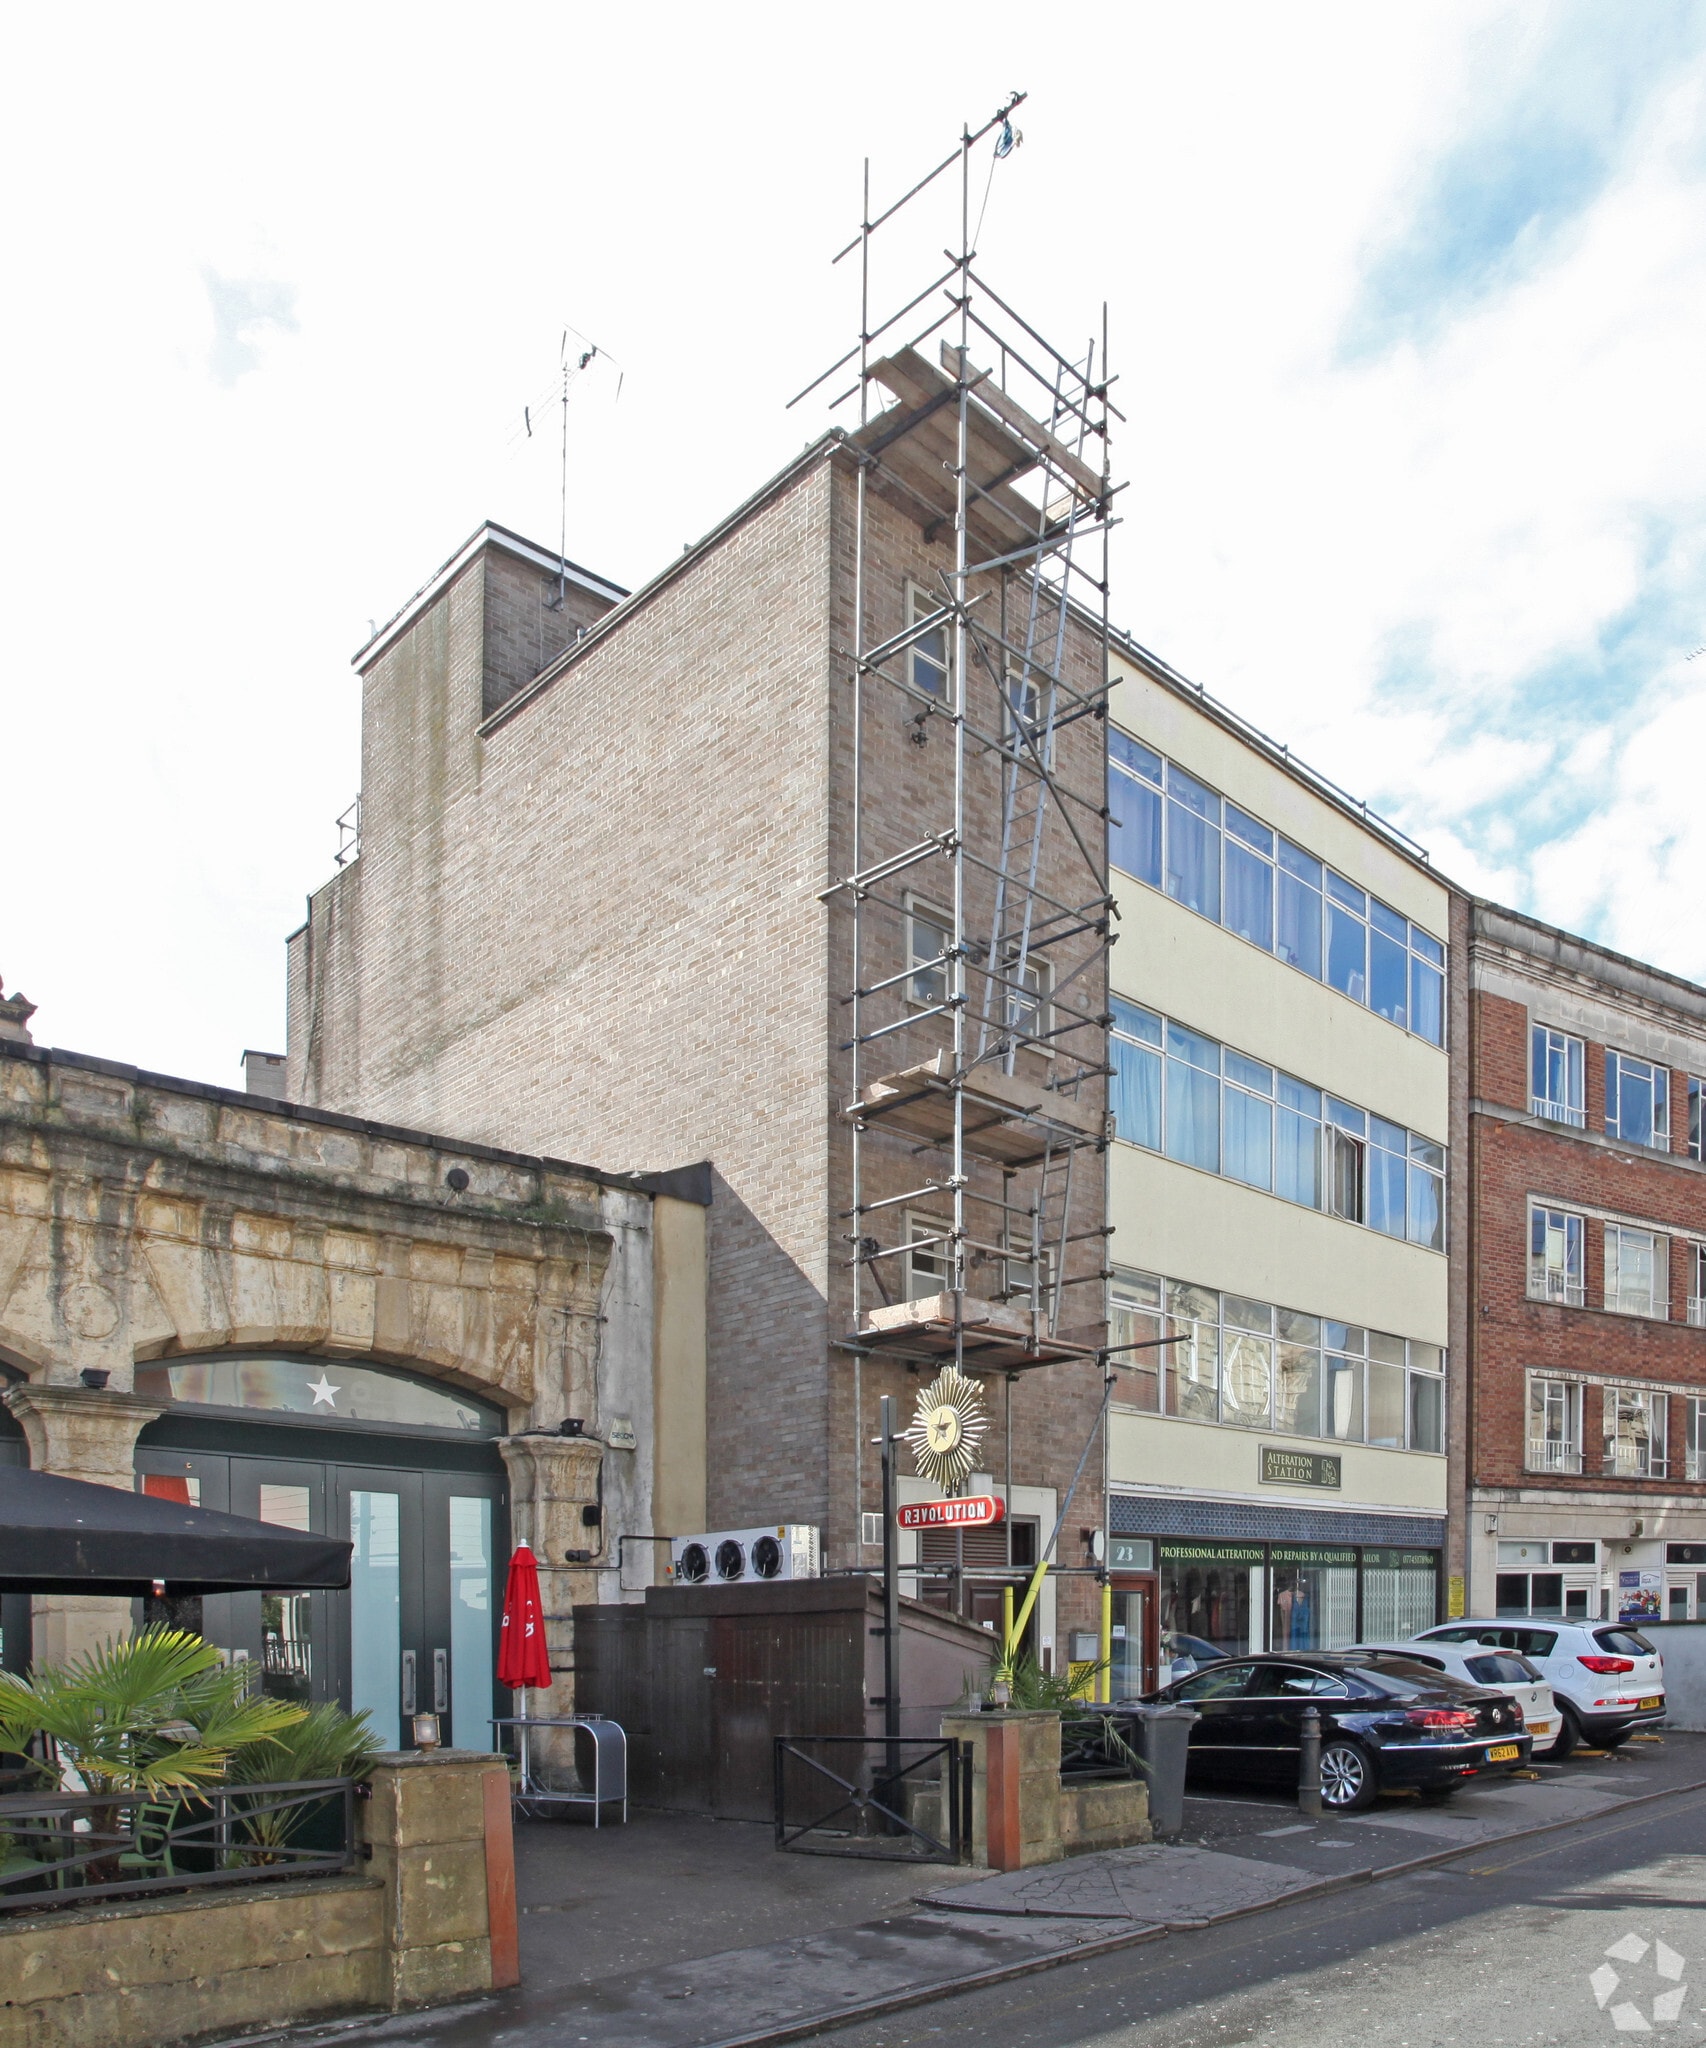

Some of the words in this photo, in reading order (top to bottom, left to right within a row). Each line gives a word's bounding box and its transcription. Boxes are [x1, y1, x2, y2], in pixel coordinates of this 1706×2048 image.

[1267, 1452, 1313, 1468] ALTERATION
[1267, 1464, 1313, 1479] STATION
[904, 1501, 986, 1524] REVOLUTION
[1116, 1546, 1133, 1561] 23
[1160, 1546, 1216, 1559] PROFESSIONAL
[1217, 1549, 1264, 1560] ALTERATIONS
[1284, 1550, 1309, 1561] REPAIRS
[1310, 1551, 1319, 1561] BY
[1319, 1552, 1324, 1561] A
[1324, 1552, 1357, 1564] QUALIFIED
